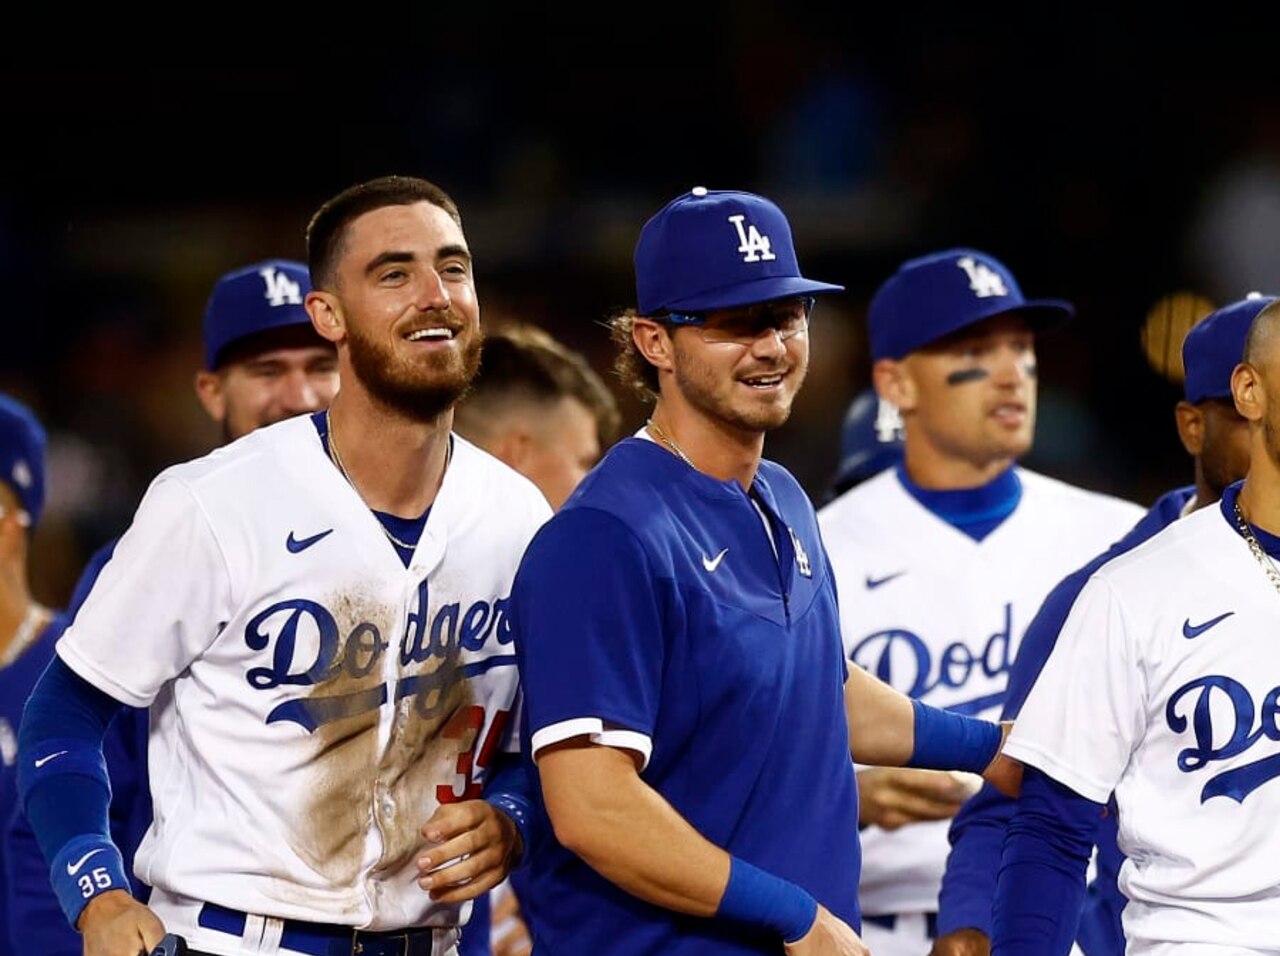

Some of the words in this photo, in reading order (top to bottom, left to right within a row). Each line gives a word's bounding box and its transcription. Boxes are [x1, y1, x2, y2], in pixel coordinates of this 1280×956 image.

[727, 214, 777, 263] LA
[259, 265, 304, 307] LA
[956, 256, 1009, 298] LA
[244, 579, 516, 720] Dodger
[78, 867, 112, 898] 35
